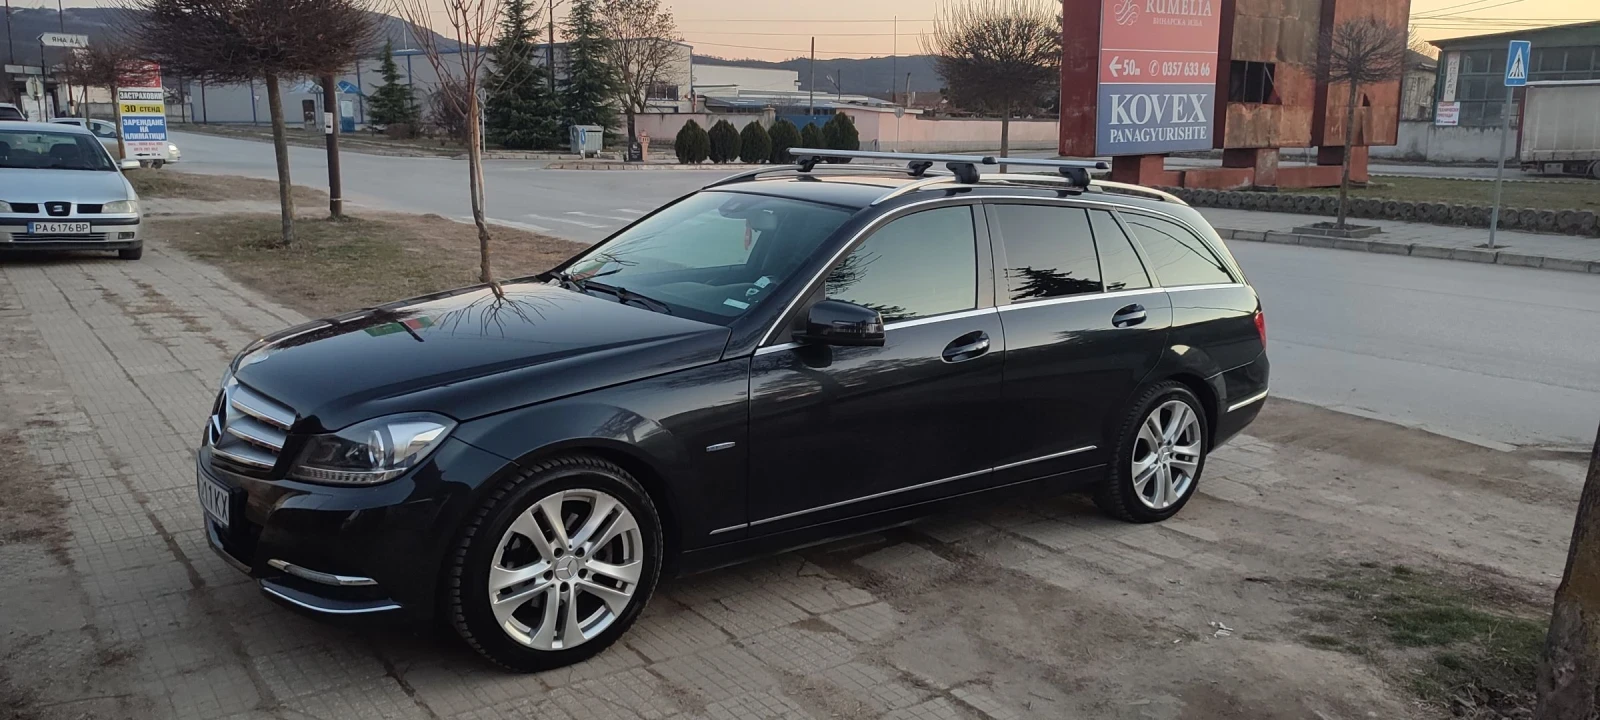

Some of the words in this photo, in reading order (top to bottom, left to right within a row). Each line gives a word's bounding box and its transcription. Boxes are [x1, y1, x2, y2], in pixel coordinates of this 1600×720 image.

[1162, 61, 1182, 76] 0357
[1184, 62, 1199, 76] 633
[1200, 63, 1211, 76] 66
[124, 104, 136, 113] 3D
[1108, 93, 1208, 125] KOVEX
[123, 118, 163, 126] ЗАРЕЖДАНЕ
[1109, 126, 1207, 143] PANAGYURISHTE
